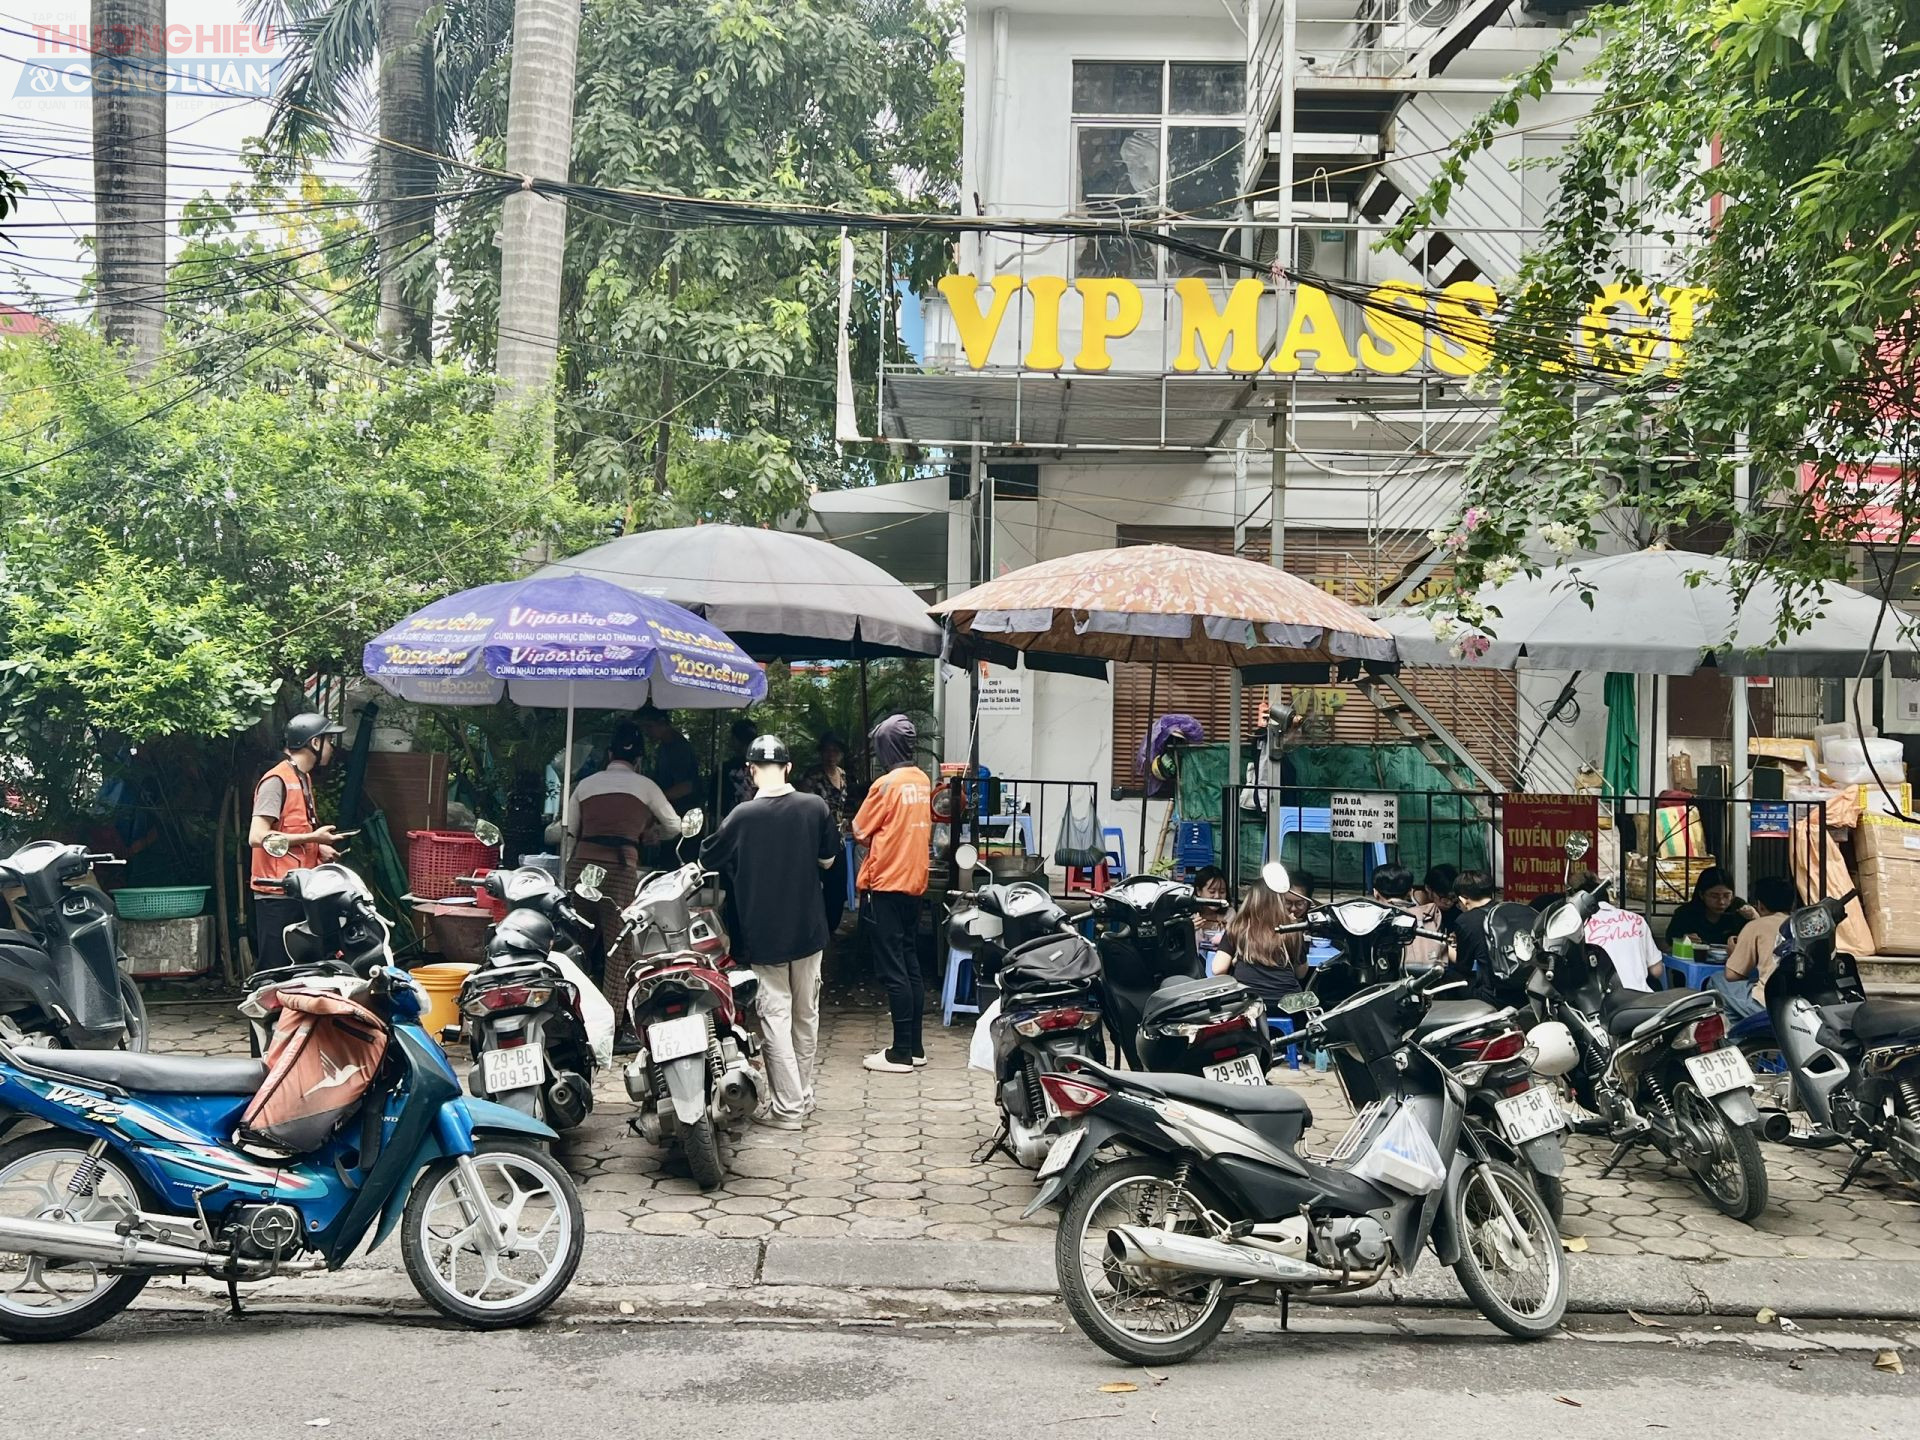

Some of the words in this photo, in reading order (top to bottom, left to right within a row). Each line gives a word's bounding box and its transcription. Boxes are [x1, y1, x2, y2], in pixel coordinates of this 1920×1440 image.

[939, 275, 1143, 371] VIP
[515, 632, 536, 641] NHAU
[597, 633, 612, 642] CAO
[516, 666, 536, 676] NHAU
[594, 667, 610, 676] CAO
[1508, 795, 1565, 805] MASSAGE
[1567, 796, 1593, 805] MEN
[1332, 808, 1356, 816] NHÂN
[1333, 819, 1355, 827] NƯỚC
[1332, 830, 1355, 838] COCA
[1507, 821, 1552, 848] TUYỂN
[1531, 857, 1561, 877] Thuật
[493, 1048, 533, 1070] 29-BC
[490, 1065, 539, 1089] 089.51
[1212, 1059, 1254, 1083] 29-BM
[44, 1085, 124, 1114] Wave
